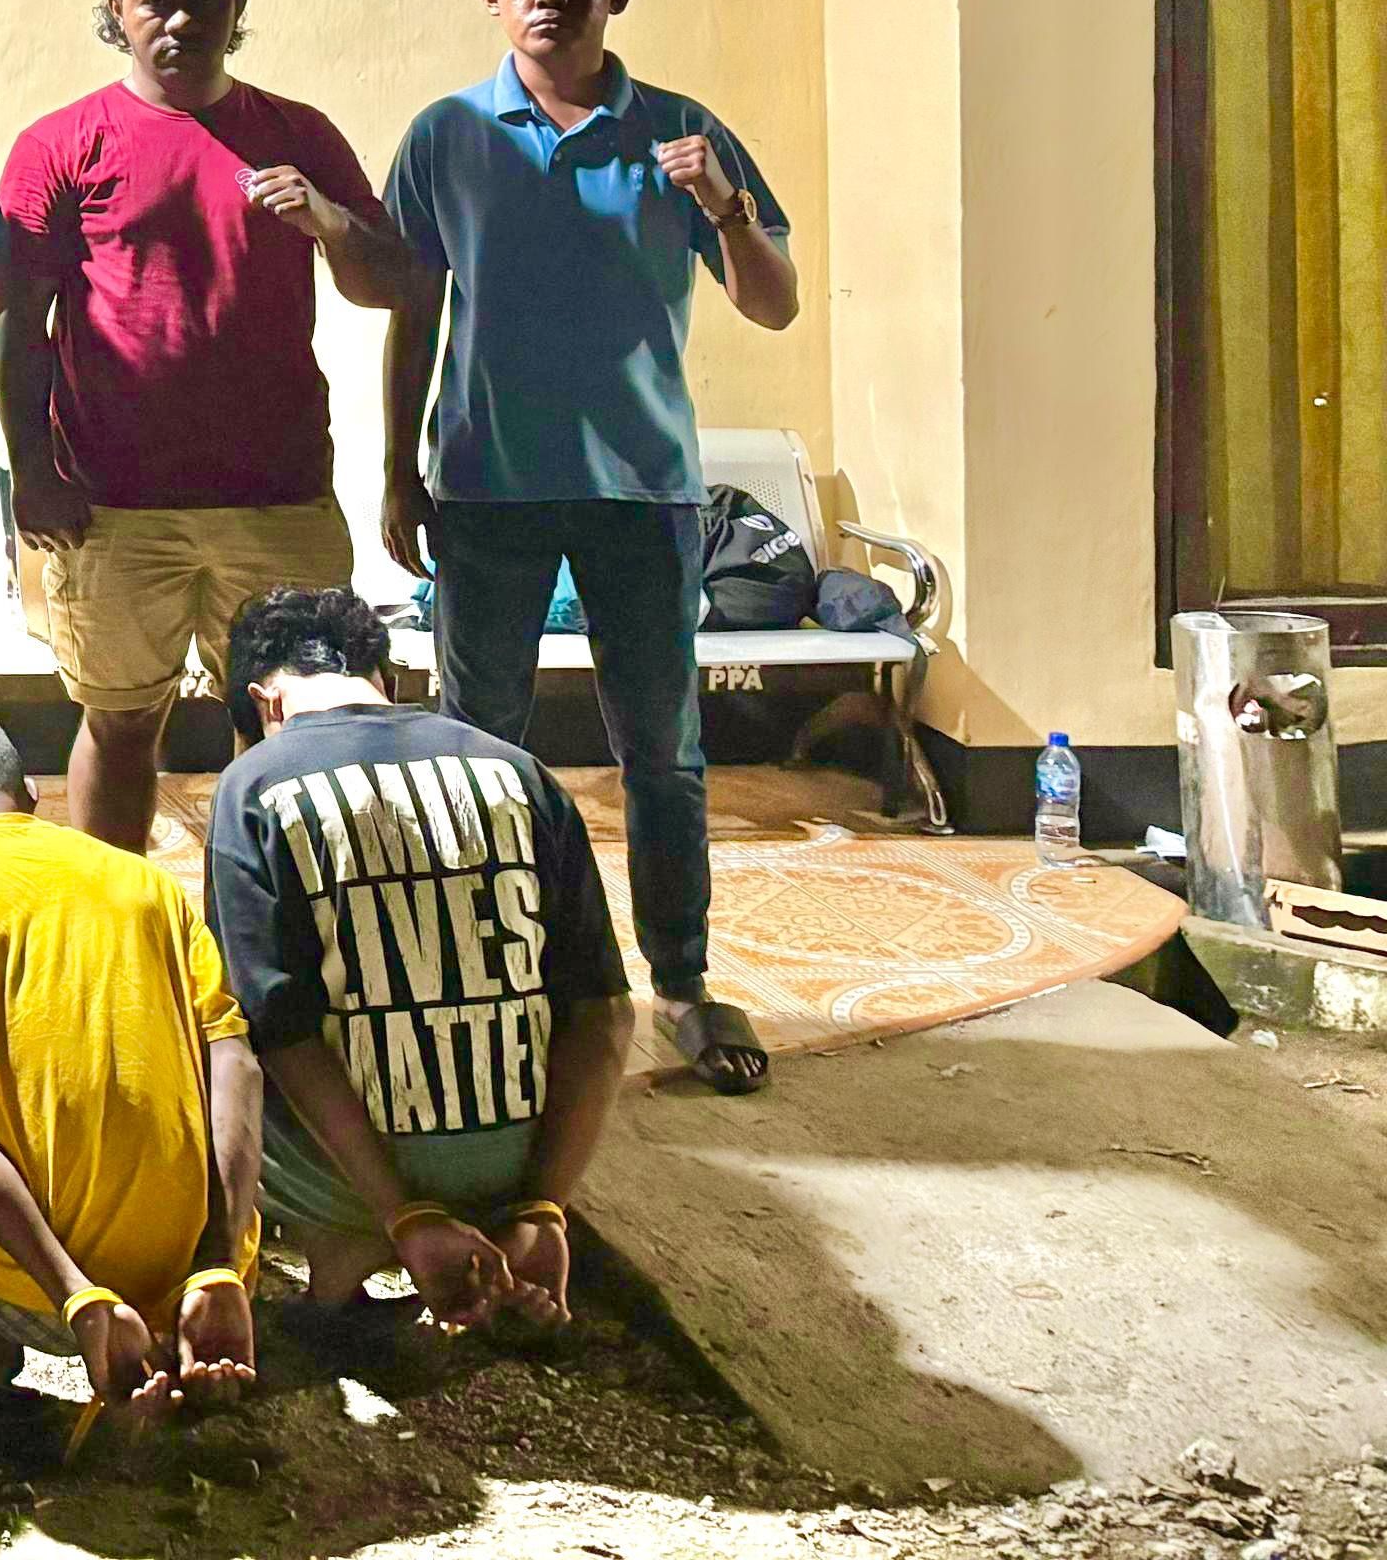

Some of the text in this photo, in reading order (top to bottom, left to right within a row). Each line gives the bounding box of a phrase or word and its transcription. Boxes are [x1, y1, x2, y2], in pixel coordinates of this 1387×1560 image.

[707, 669, 764, 691] PPA
[259, 754, 537, 896] TIMUR
[310, 868, 547, 1012] LIVES
